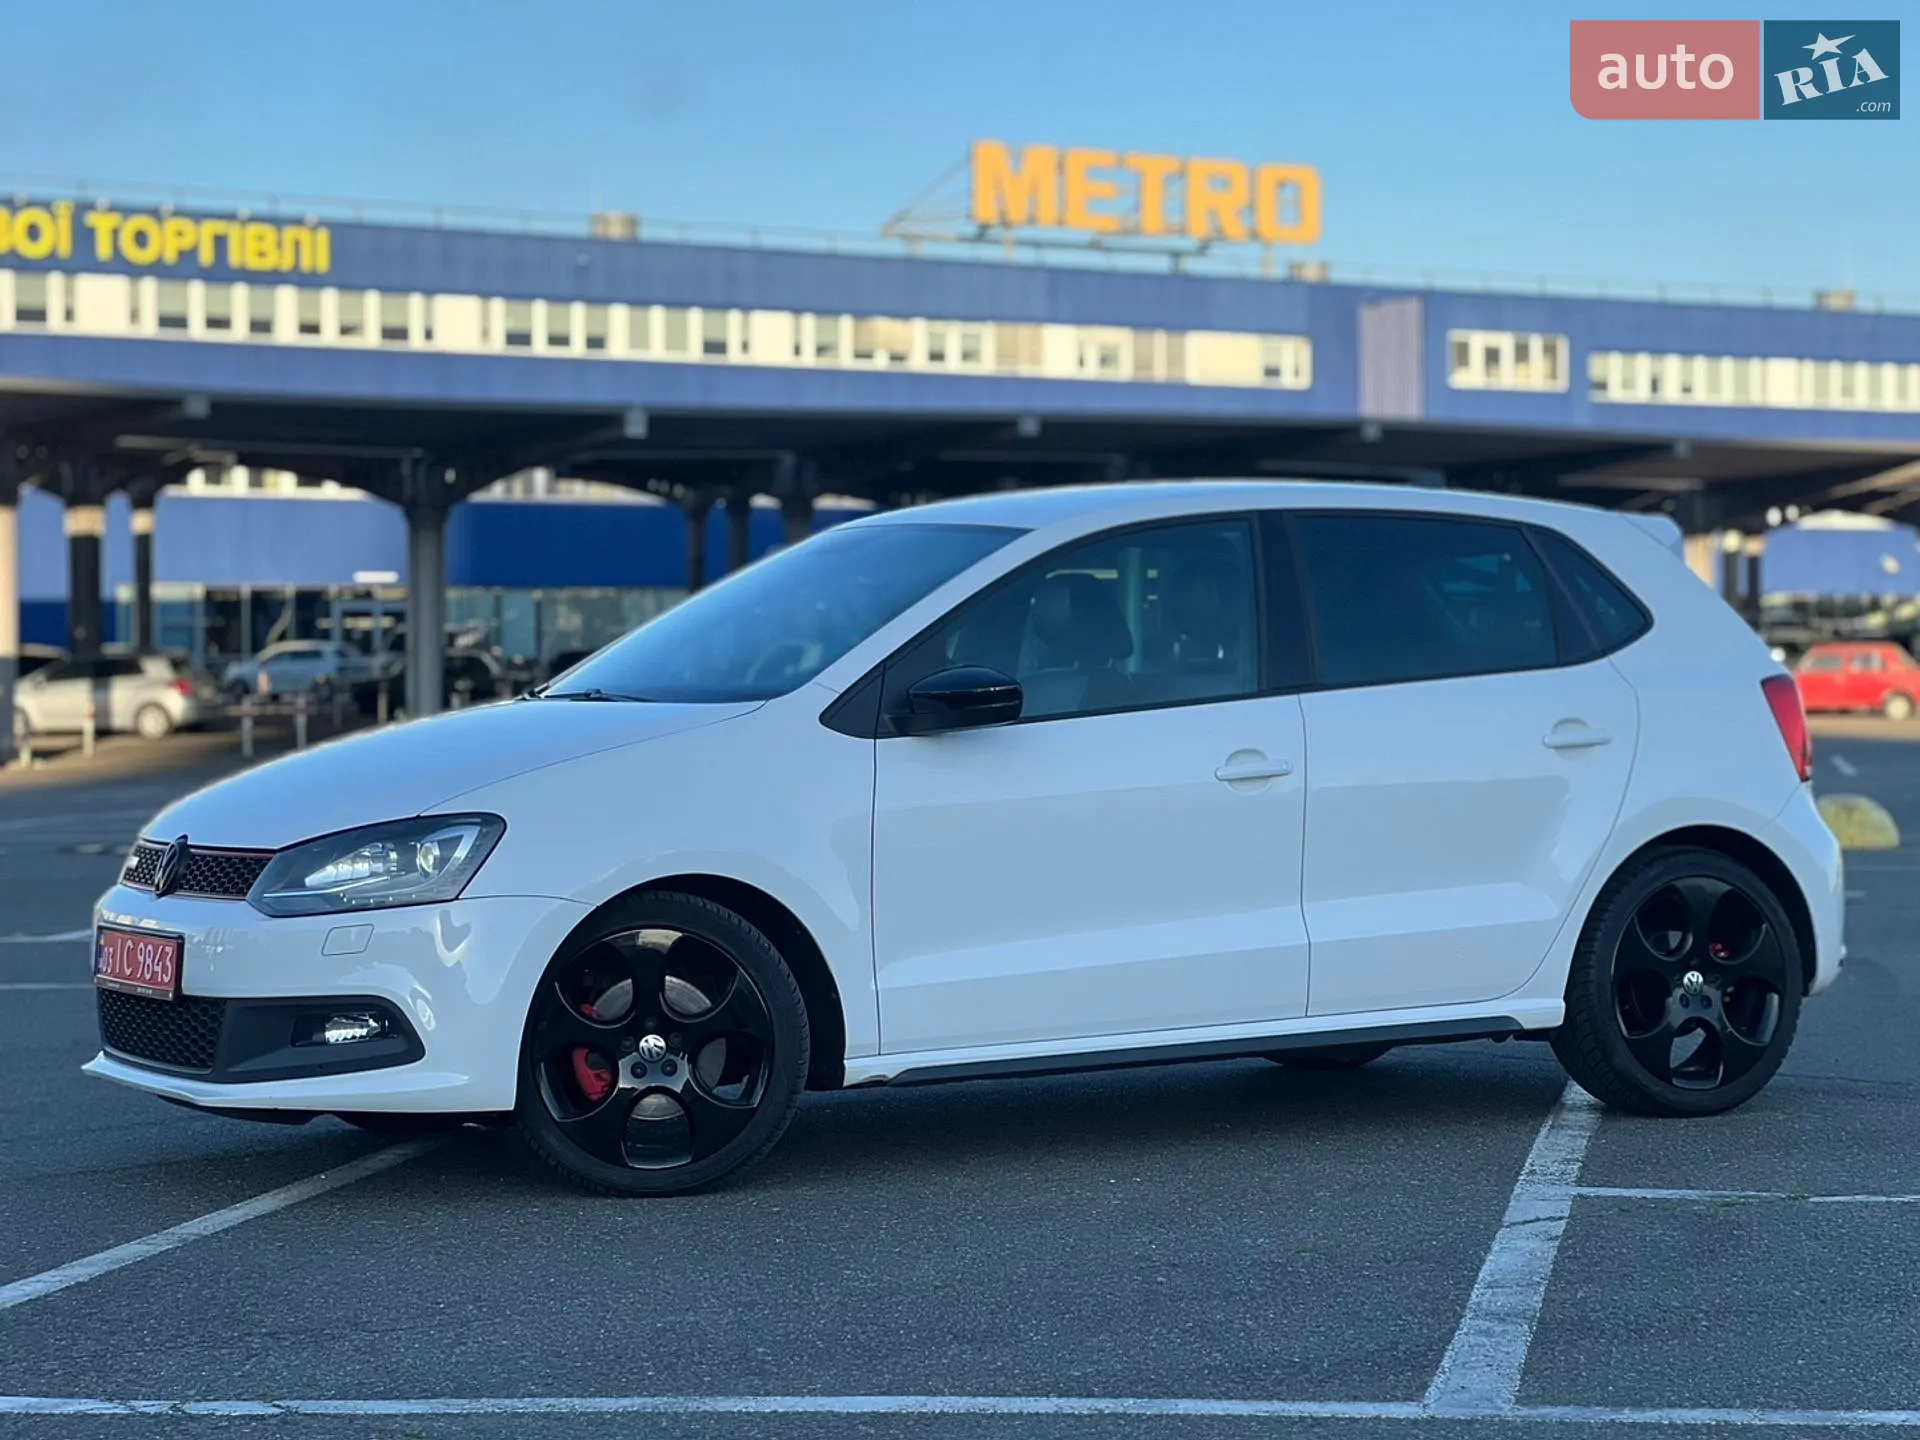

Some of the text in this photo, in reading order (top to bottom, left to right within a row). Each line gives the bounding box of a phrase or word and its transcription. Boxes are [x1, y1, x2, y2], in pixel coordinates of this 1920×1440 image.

[972, 140, 1321, 245] METRO
[84, 210, 330, 275] ТОРГІВЛІ
[137, 942, 173, 983] 9843
